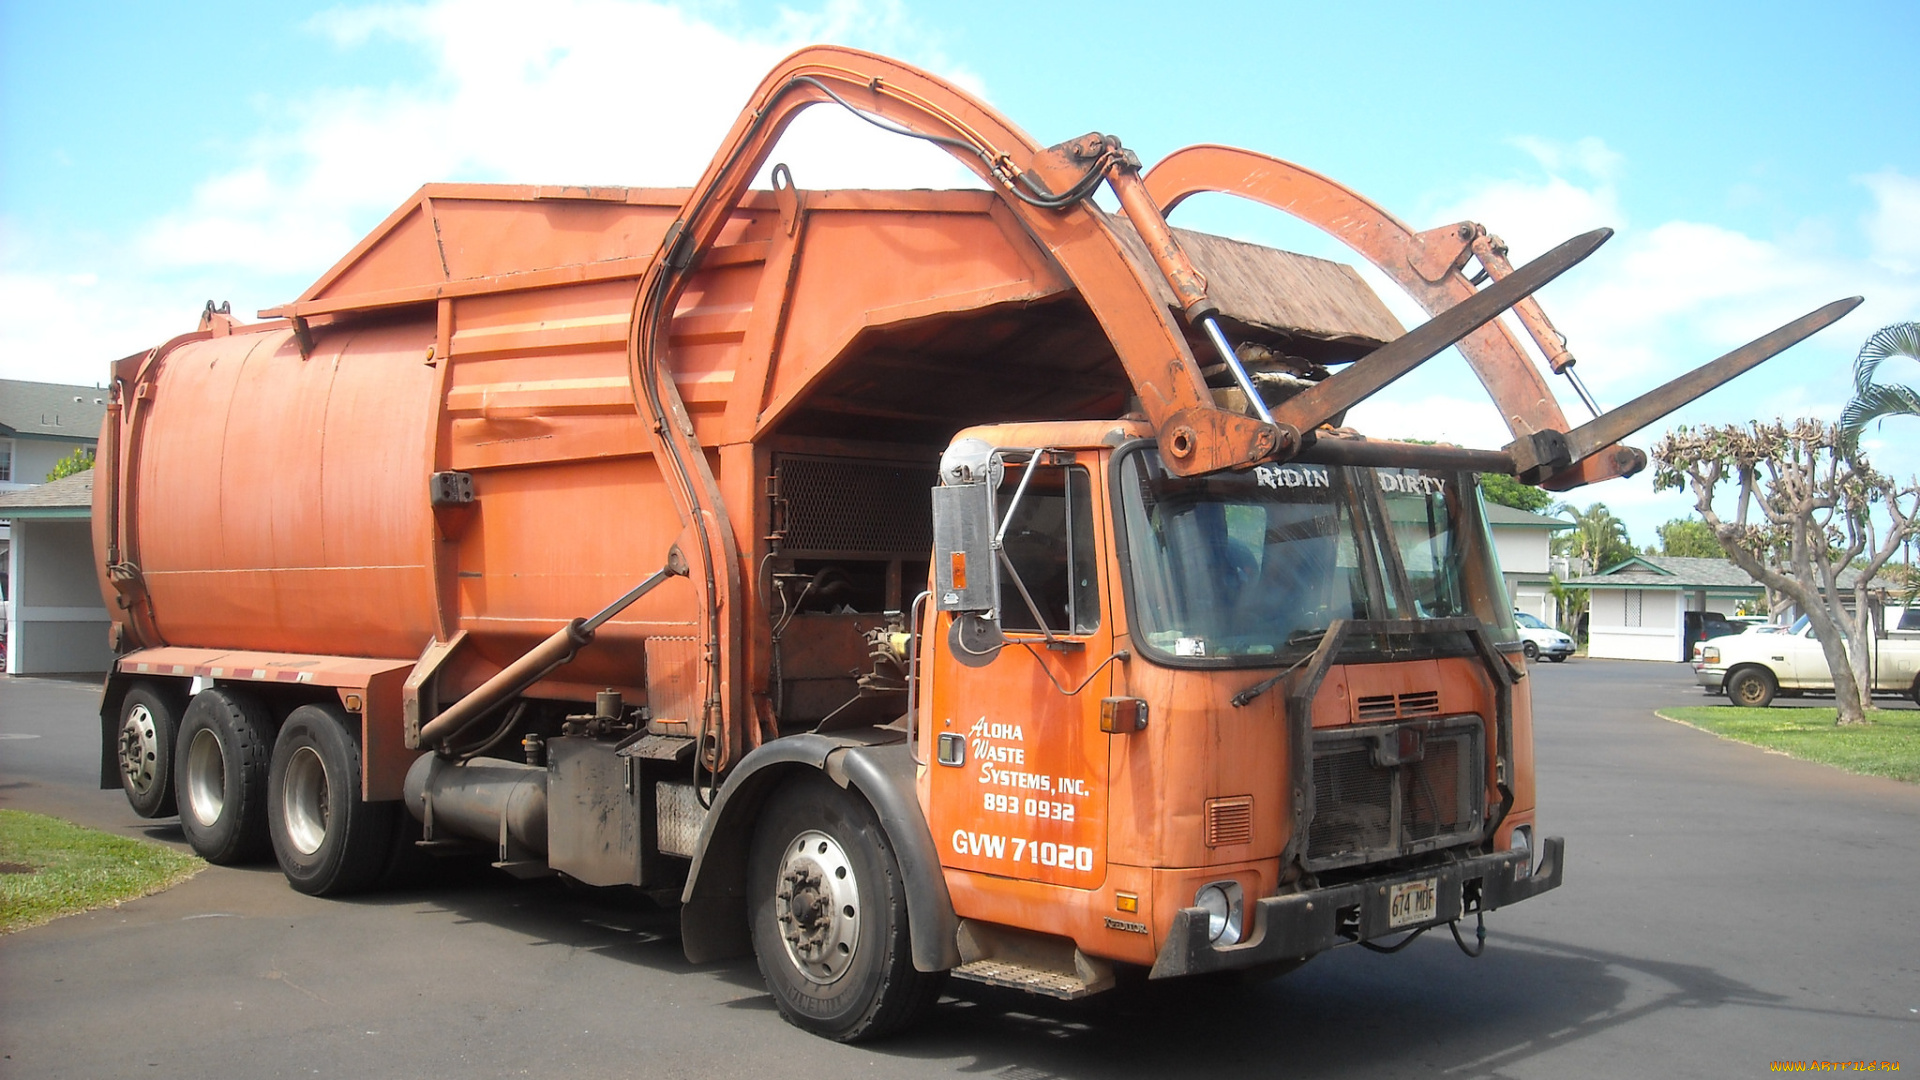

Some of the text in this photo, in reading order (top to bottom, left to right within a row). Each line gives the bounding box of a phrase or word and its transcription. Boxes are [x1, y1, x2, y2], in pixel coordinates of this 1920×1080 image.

[1253, 465, 1446, 496] RIDIN DIRTY
[968, 716, 1024, 741] ALOHA
[971, 738, 1025, 764] WASTE
[978, 762, 1090, 797] SYSTEMS, INC.
[984, 793, 1075, 822] 893 0932
[952, 829, 1093, 872] GVW 71020
[1392, 893, 1411, 917] 674
